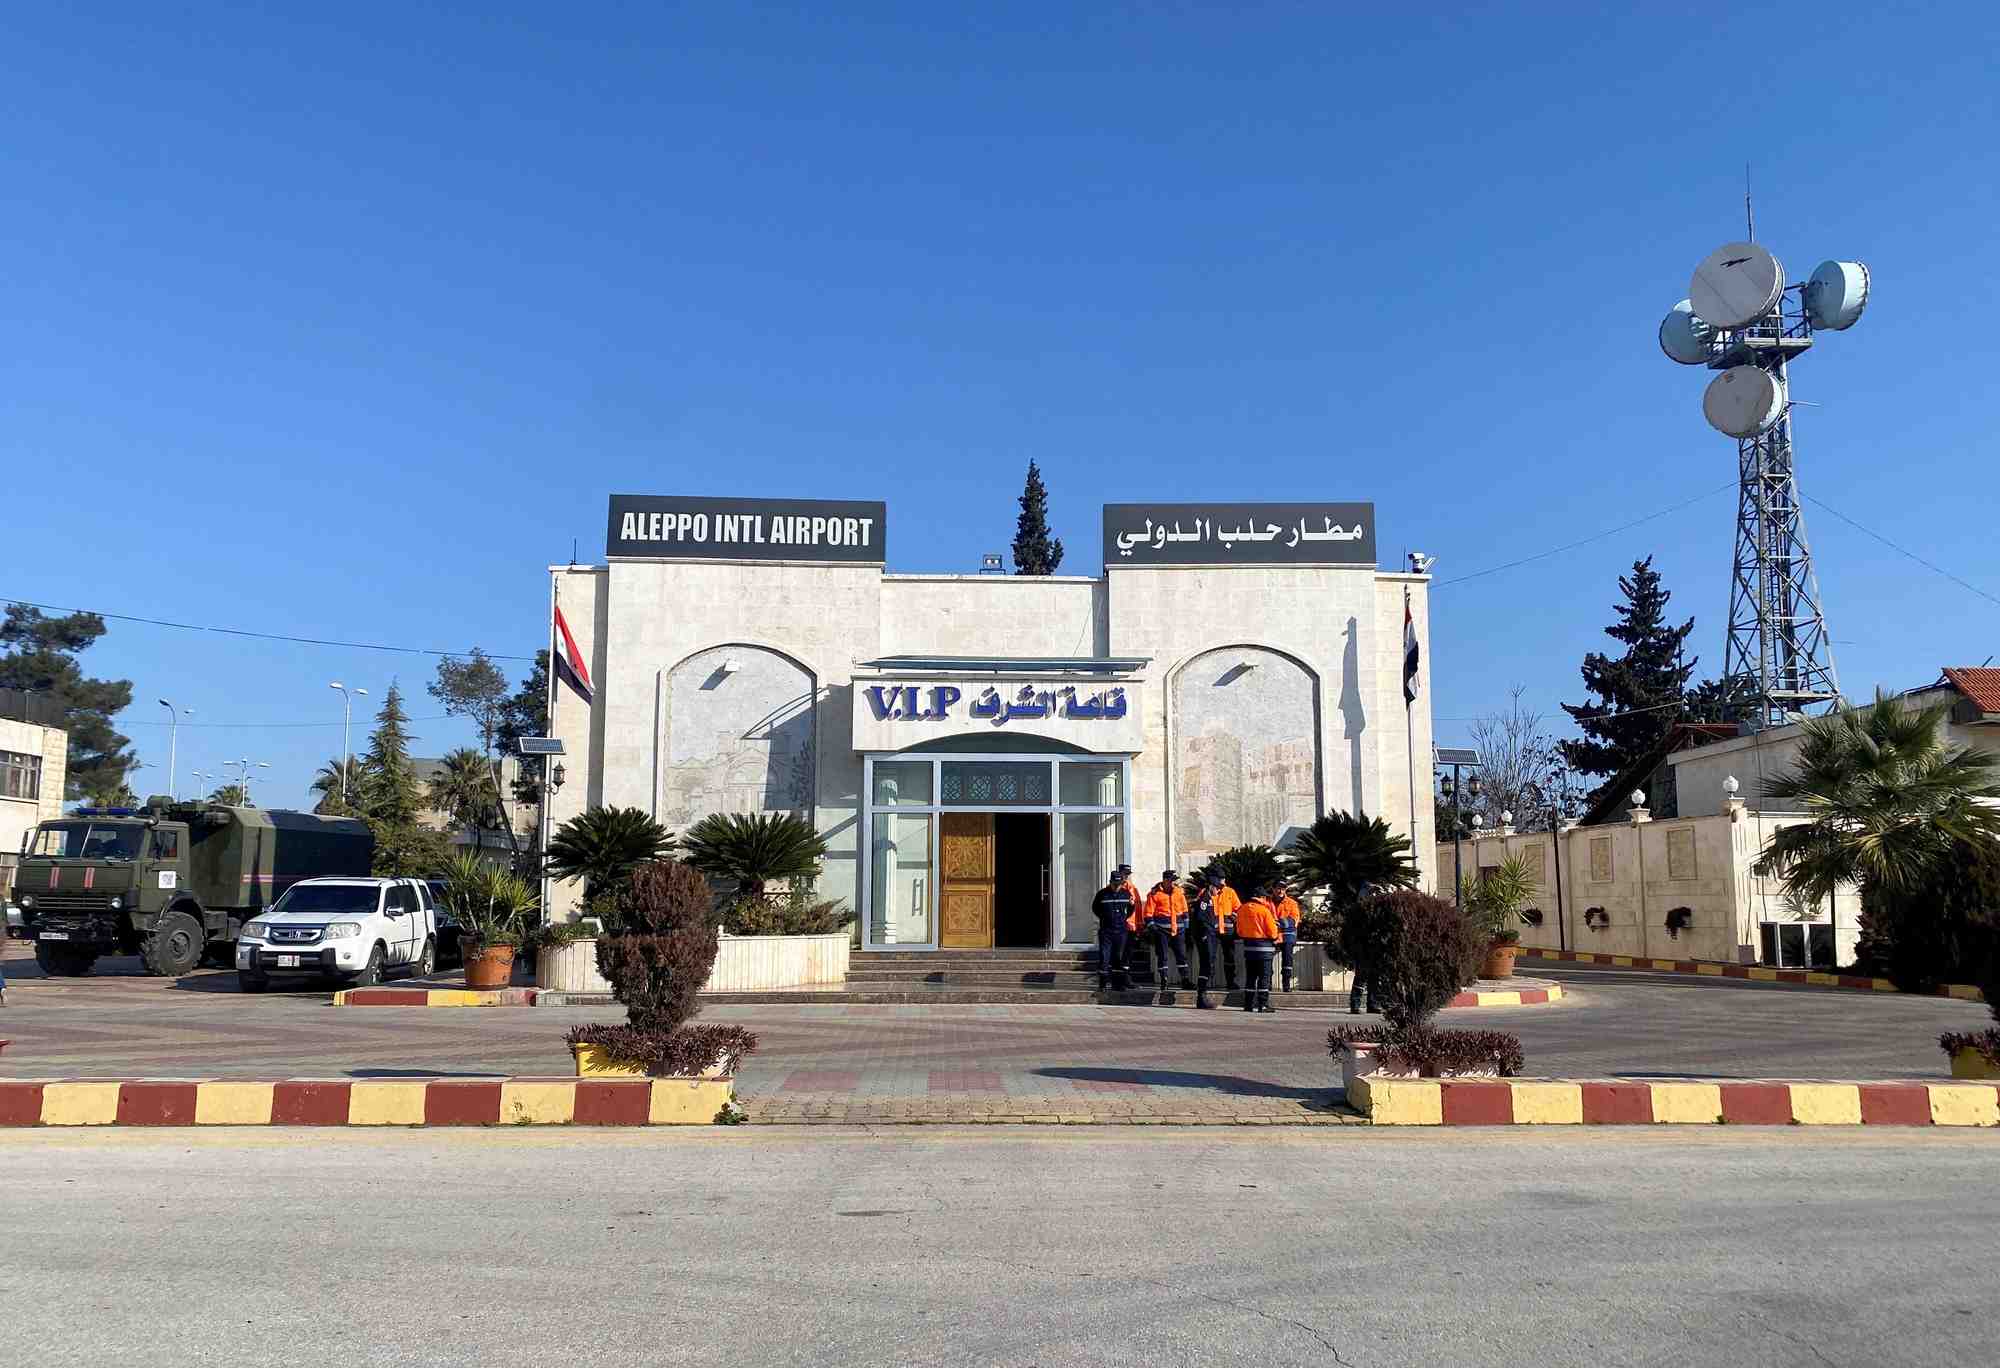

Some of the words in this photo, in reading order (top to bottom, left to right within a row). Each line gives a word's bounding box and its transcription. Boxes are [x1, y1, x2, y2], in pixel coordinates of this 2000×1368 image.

[620, 512, 709, 542] ALEPPO
[714, 514, 765, 543] INTL
[769, 515, 873, 546] AIRPORT
[1116, 517, 1211, 556] الدولي
[1217, 517, 1284, 549] حلب
[1285, 516, 1363, 549] مطار
[864, 686, 961, 720] V.I.P
[970, 685, 1056, 726] الشرف
[1058, 686, 1128, 719] قاعة
